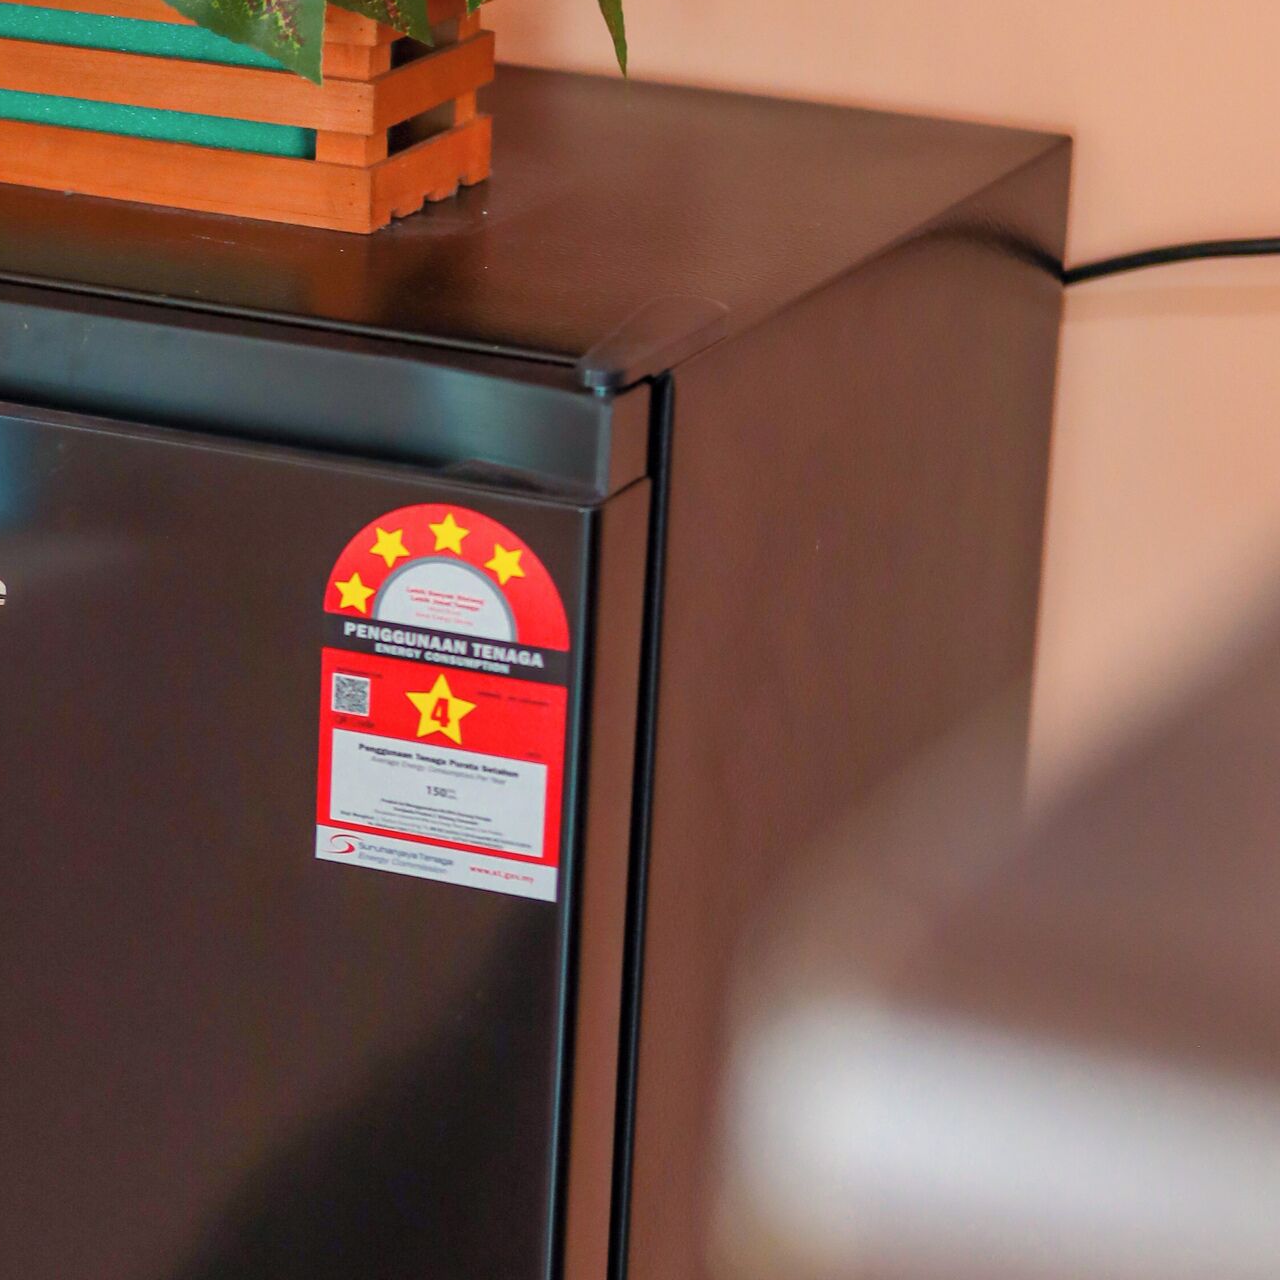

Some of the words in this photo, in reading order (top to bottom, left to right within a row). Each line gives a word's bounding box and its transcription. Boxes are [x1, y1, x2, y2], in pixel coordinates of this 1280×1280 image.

[343, 621, 468, 655] PENGGUNAAN
[470, 642, 545, 669] TENAGA
[374, 641, 422, 660] ENERGY
[423, 651, 511, 675] CONSUMPTION
[431, 697, 450, 728] 4
